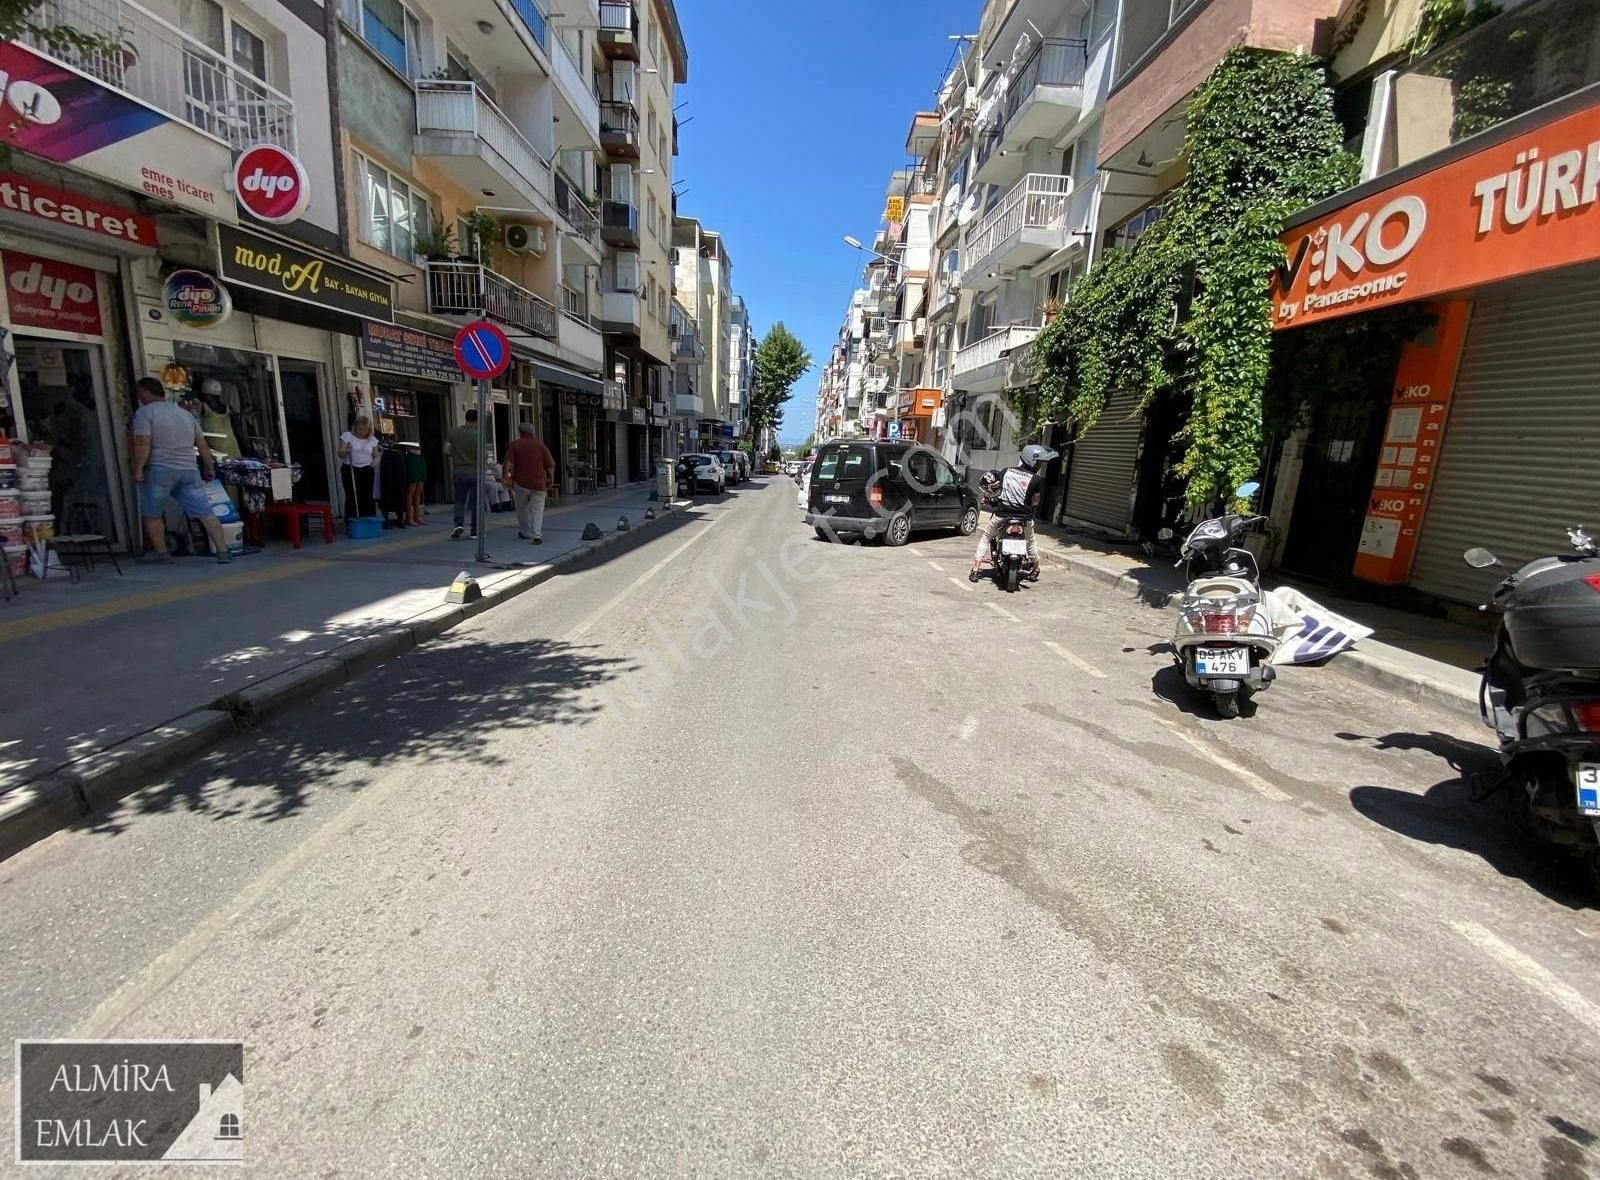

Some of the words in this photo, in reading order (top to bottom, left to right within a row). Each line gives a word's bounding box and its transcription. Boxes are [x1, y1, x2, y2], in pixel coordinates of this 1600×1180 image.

[141, 167, 174, 187] emre
[176, 179, 214, 204] ticaret
[143, 181, 174, 200] enes
[243, 168, 295, 198] dyo
[0, 181, 139, 240] ticaret
[9, 262, 94, 310] dyo
[178, 286, 214, 304] dyo
[324, 276, 339, 290] BAY
[1279, 301, 1300, 319] by
[1303, 271, 1408, 311] Panasonic
[889, 423, 898, 437] P
[1211, 661, 1237, 673] 476
